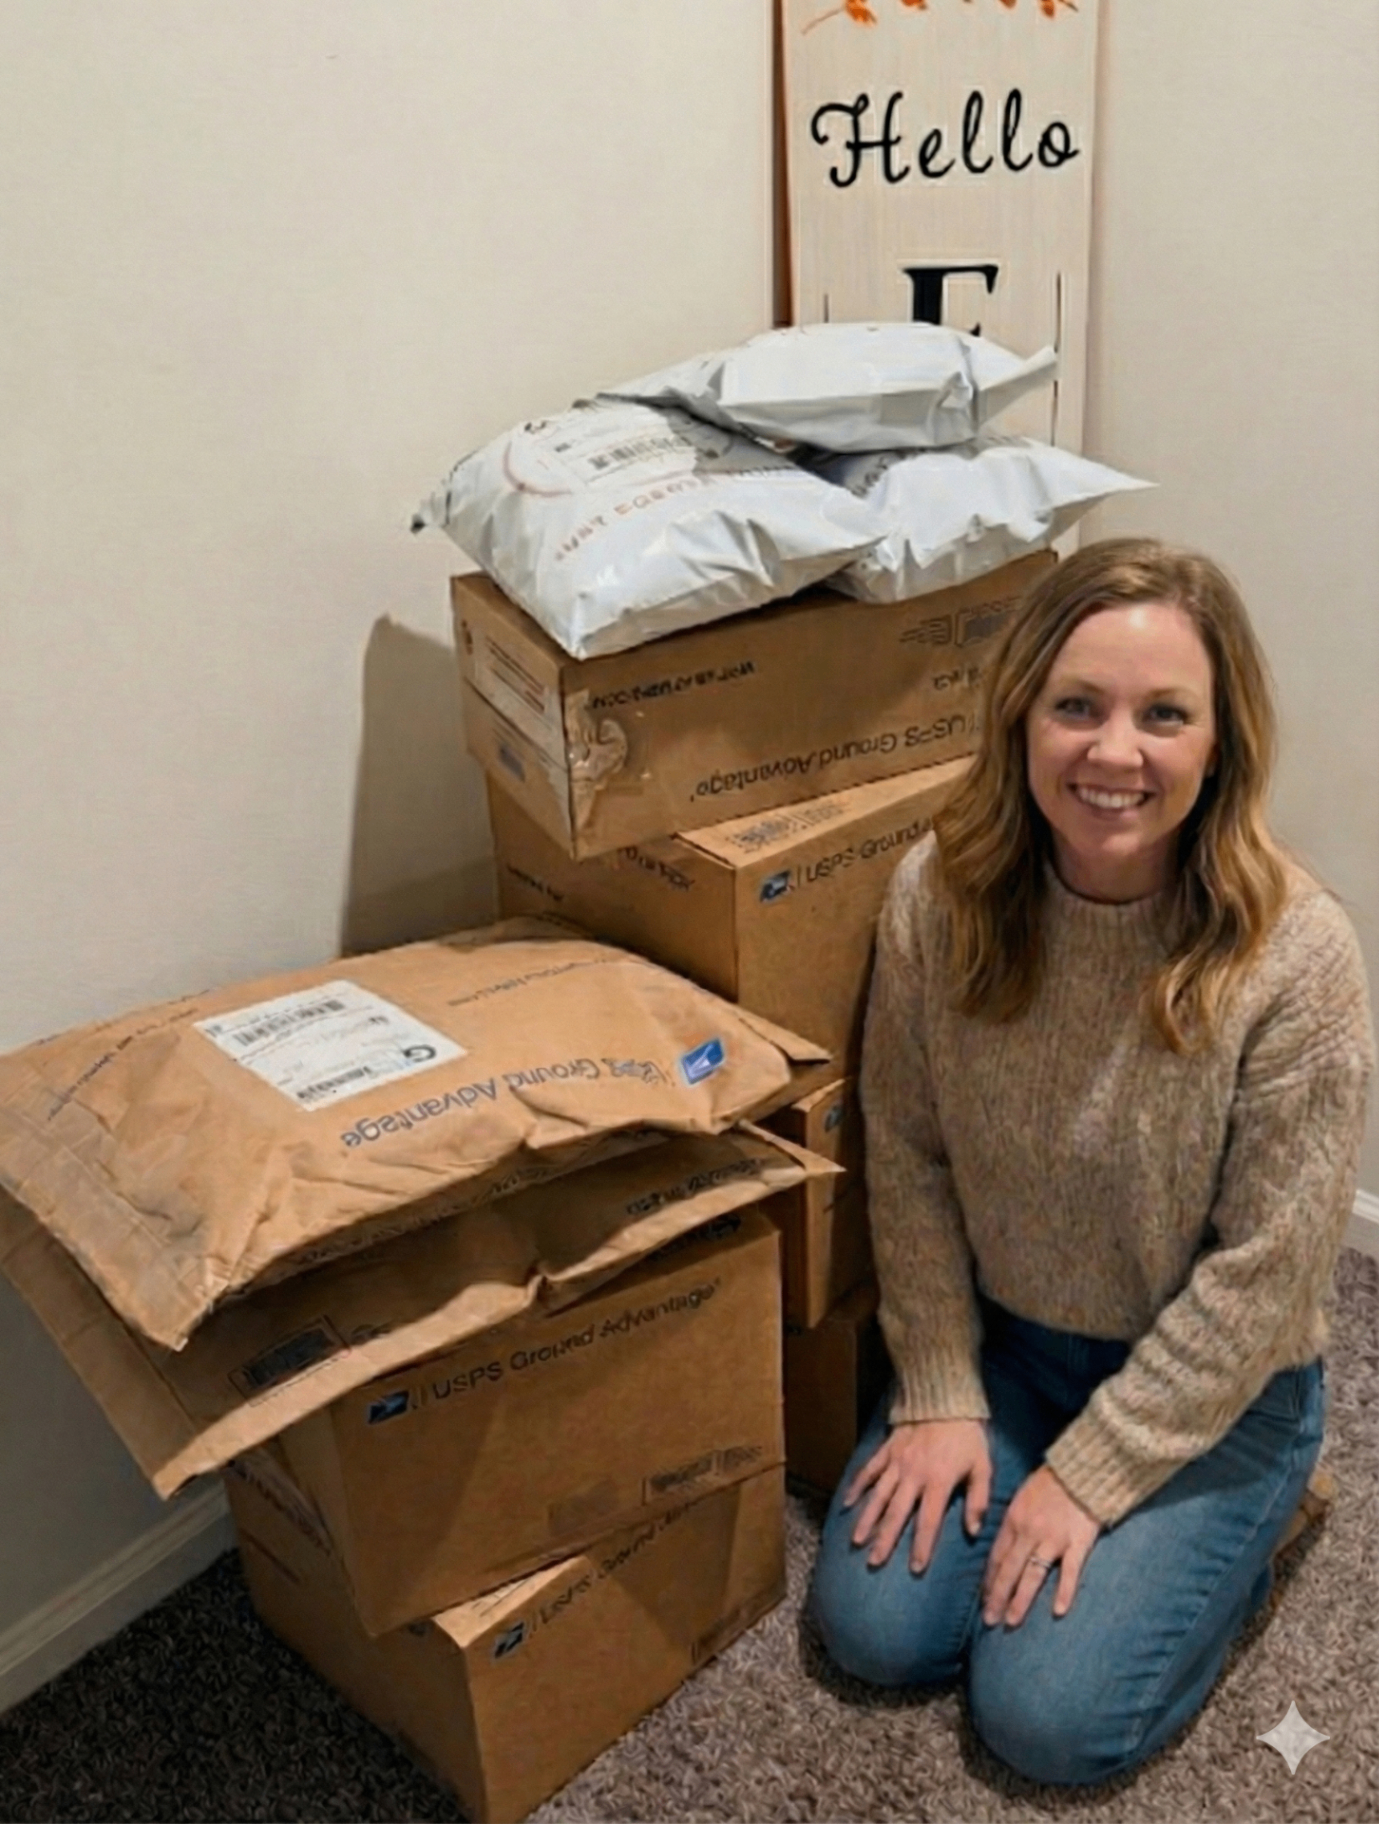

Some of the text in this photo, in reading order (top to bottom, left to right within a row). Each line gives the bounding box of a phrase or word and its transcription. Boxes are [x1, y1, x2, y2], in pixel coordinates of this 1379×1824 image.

[810, 88, 1080, 188] Hello
[819, 732, 898, 769] Ground
[340, 1077, 499, 1148] Advantage
[432, 1360, 504, 1401] USPS
[510, 1323, 596, 1372] Ground
